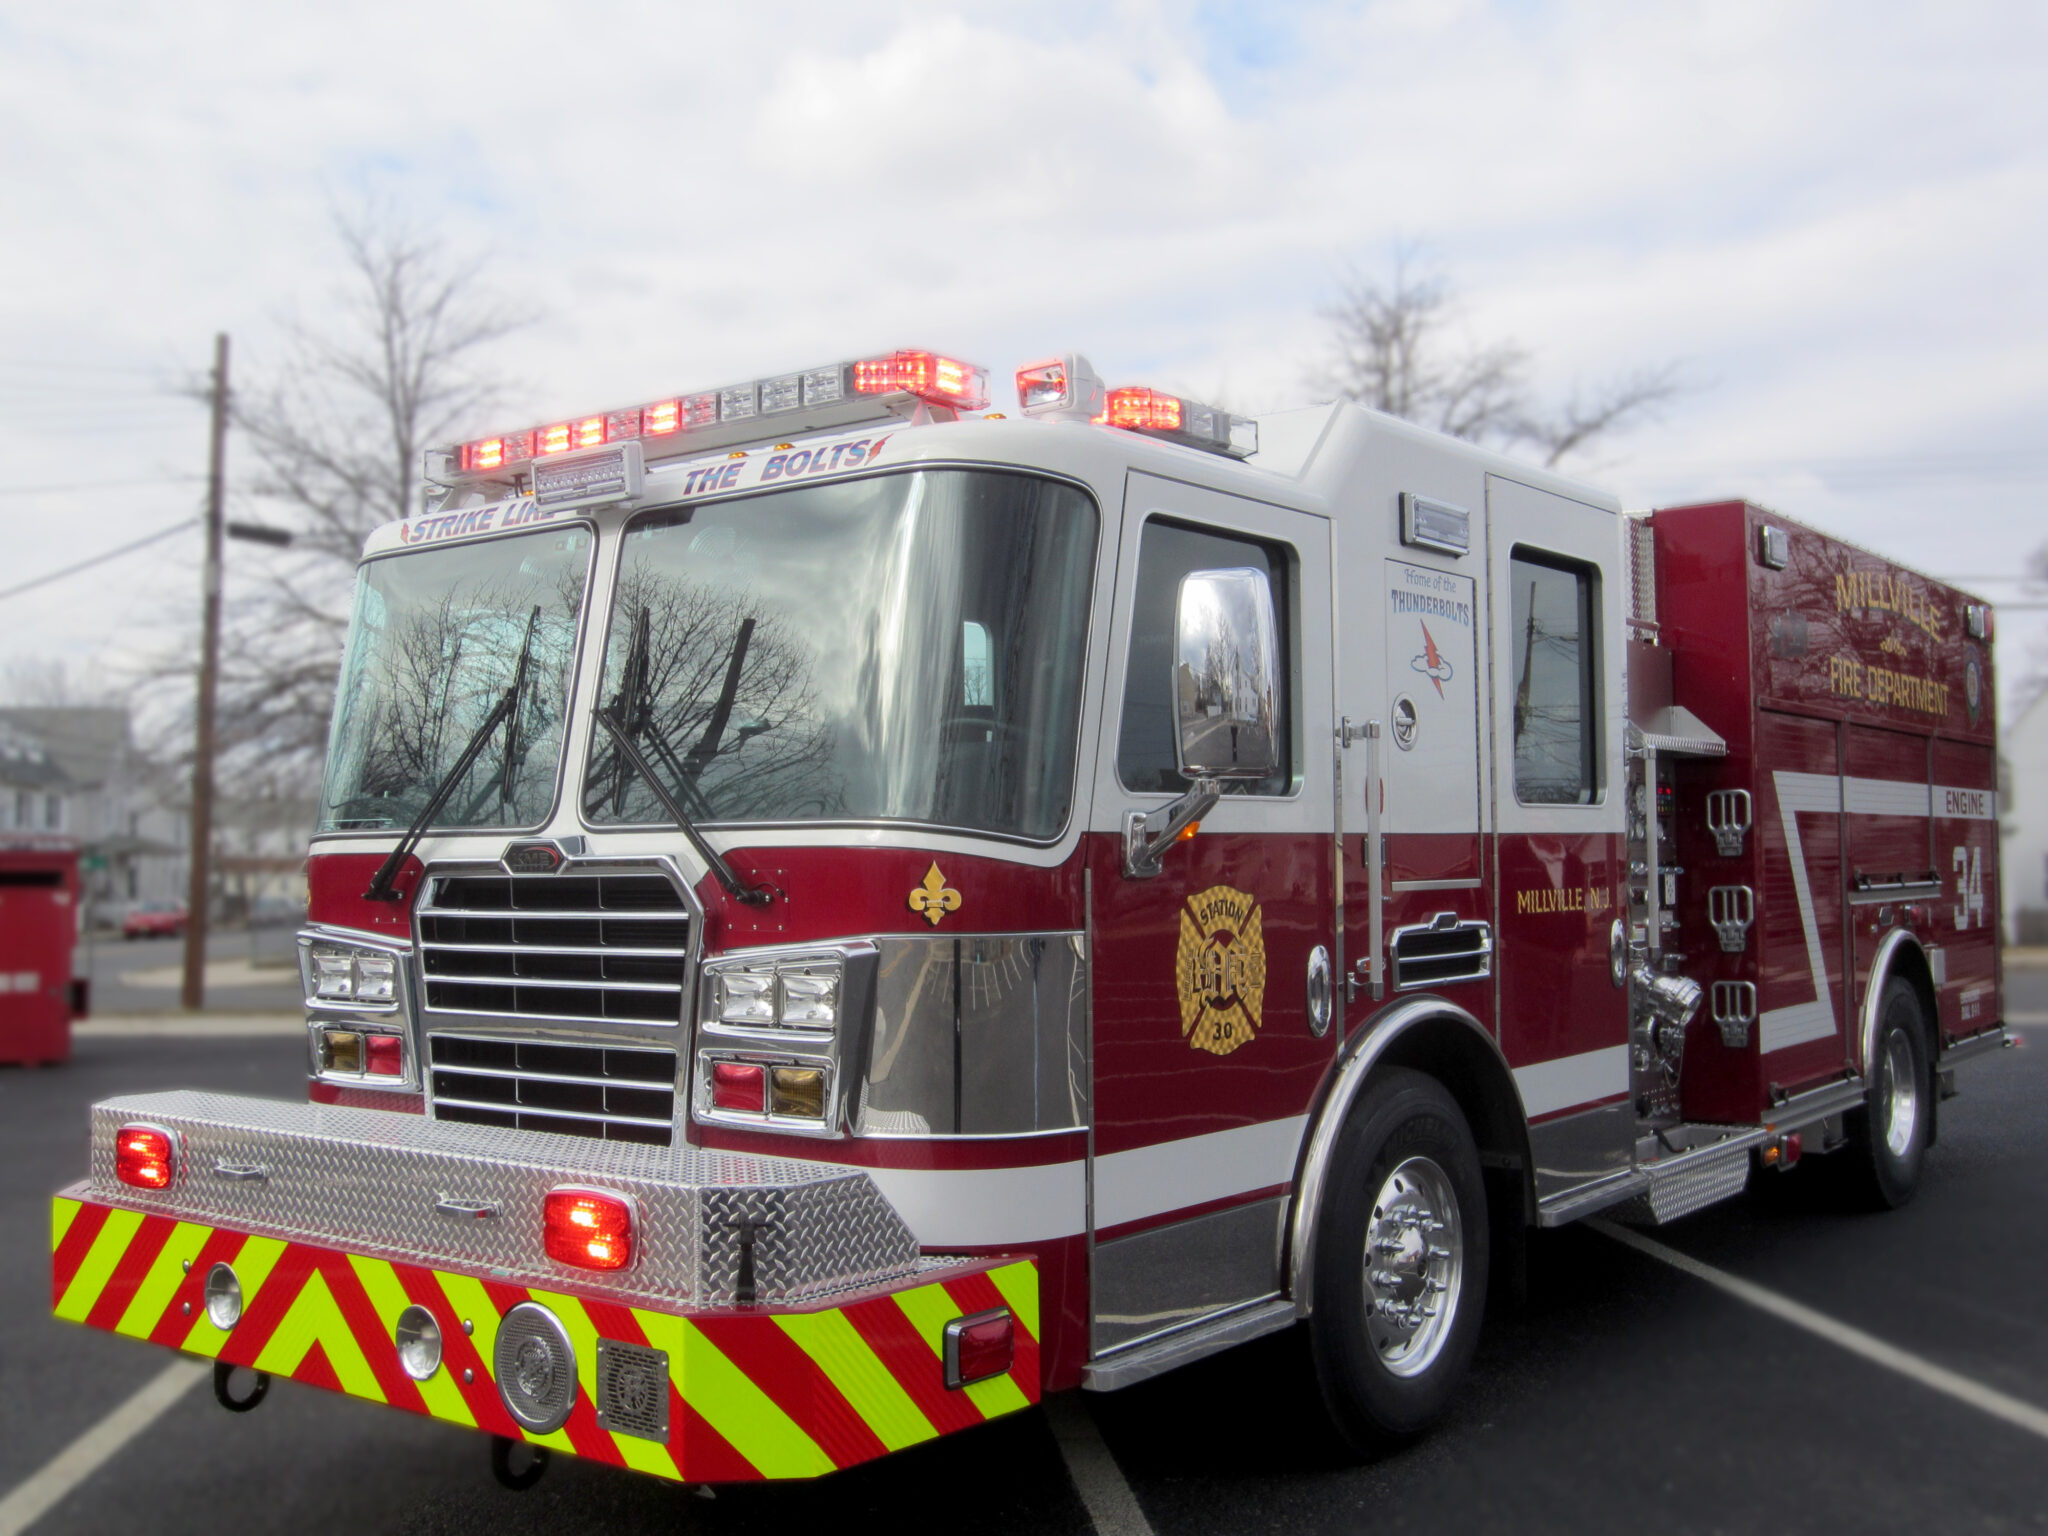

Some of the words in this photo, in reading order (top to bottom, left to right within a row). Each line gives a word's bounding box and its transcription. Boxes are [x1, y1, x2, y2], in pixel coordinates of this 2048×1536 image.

[683, 461, 747, 496] THE
[760, 439, 872, 482] BOLTS
[410, 506, 500, 543] STRIKE
[501, 500, 556, 527] LIK
[1404, 568, 1431, 588] Home
[1433, 576, 1443, 592] of
[1443, 578, 1457, 594] the
[1391, 589, 1469, 627] THUNDERBOLTS
[1835, 572, 1942, 643] MILLVILLE
[1830, 656, 1862, 698] FIRE
[1867, 665, 1949, 717] DEPARTMENT
[1946, 791, 1984, 816] ENGINE
[1953, 846, 1984, 931] 34
[1200, 899, 1243, 926] STATION
[1213, 1022, 1232, 1041] 30
